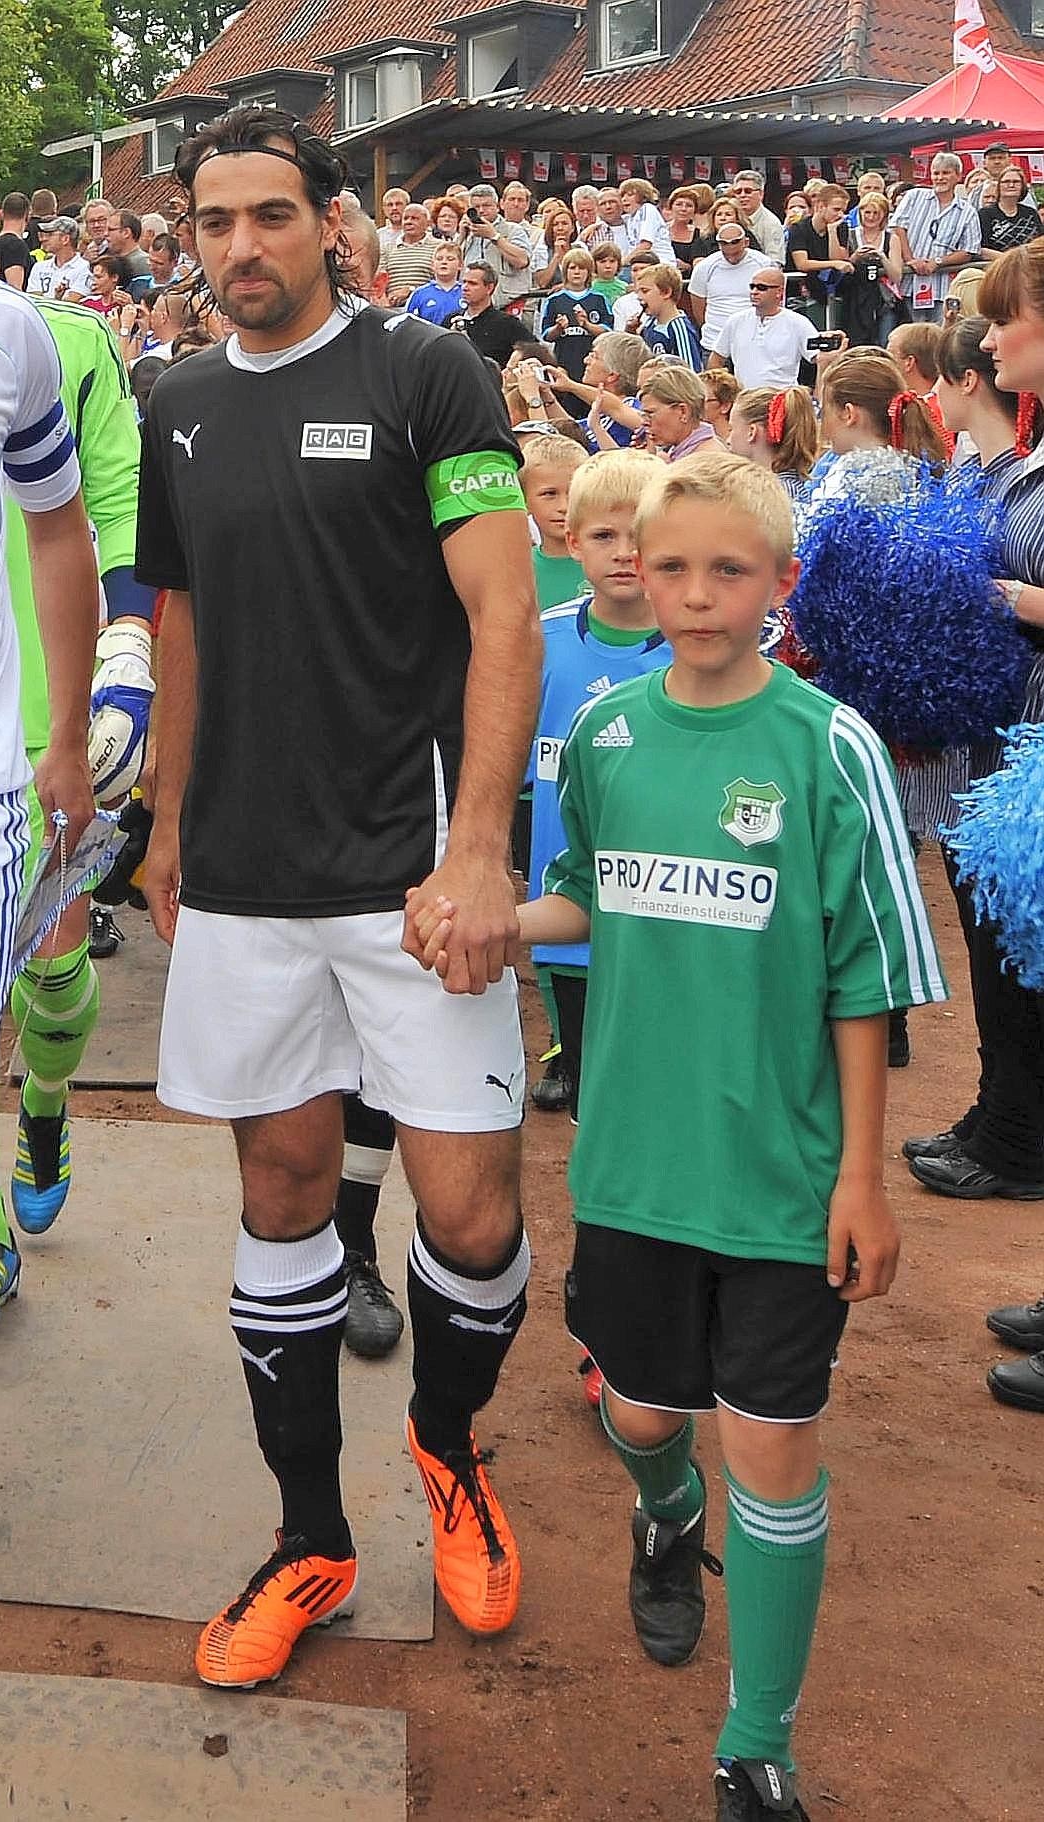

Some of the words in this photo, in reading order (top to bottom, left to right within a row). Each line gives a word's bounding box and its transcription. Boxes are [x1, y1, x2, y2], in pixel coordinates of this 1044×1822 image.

[307, 430, 367, 448] RAG
[592, 736, 634, 747] adidas
[92, 736, 117, 779] usch
[597, 857, 772, 904] PRO/ZINSO
